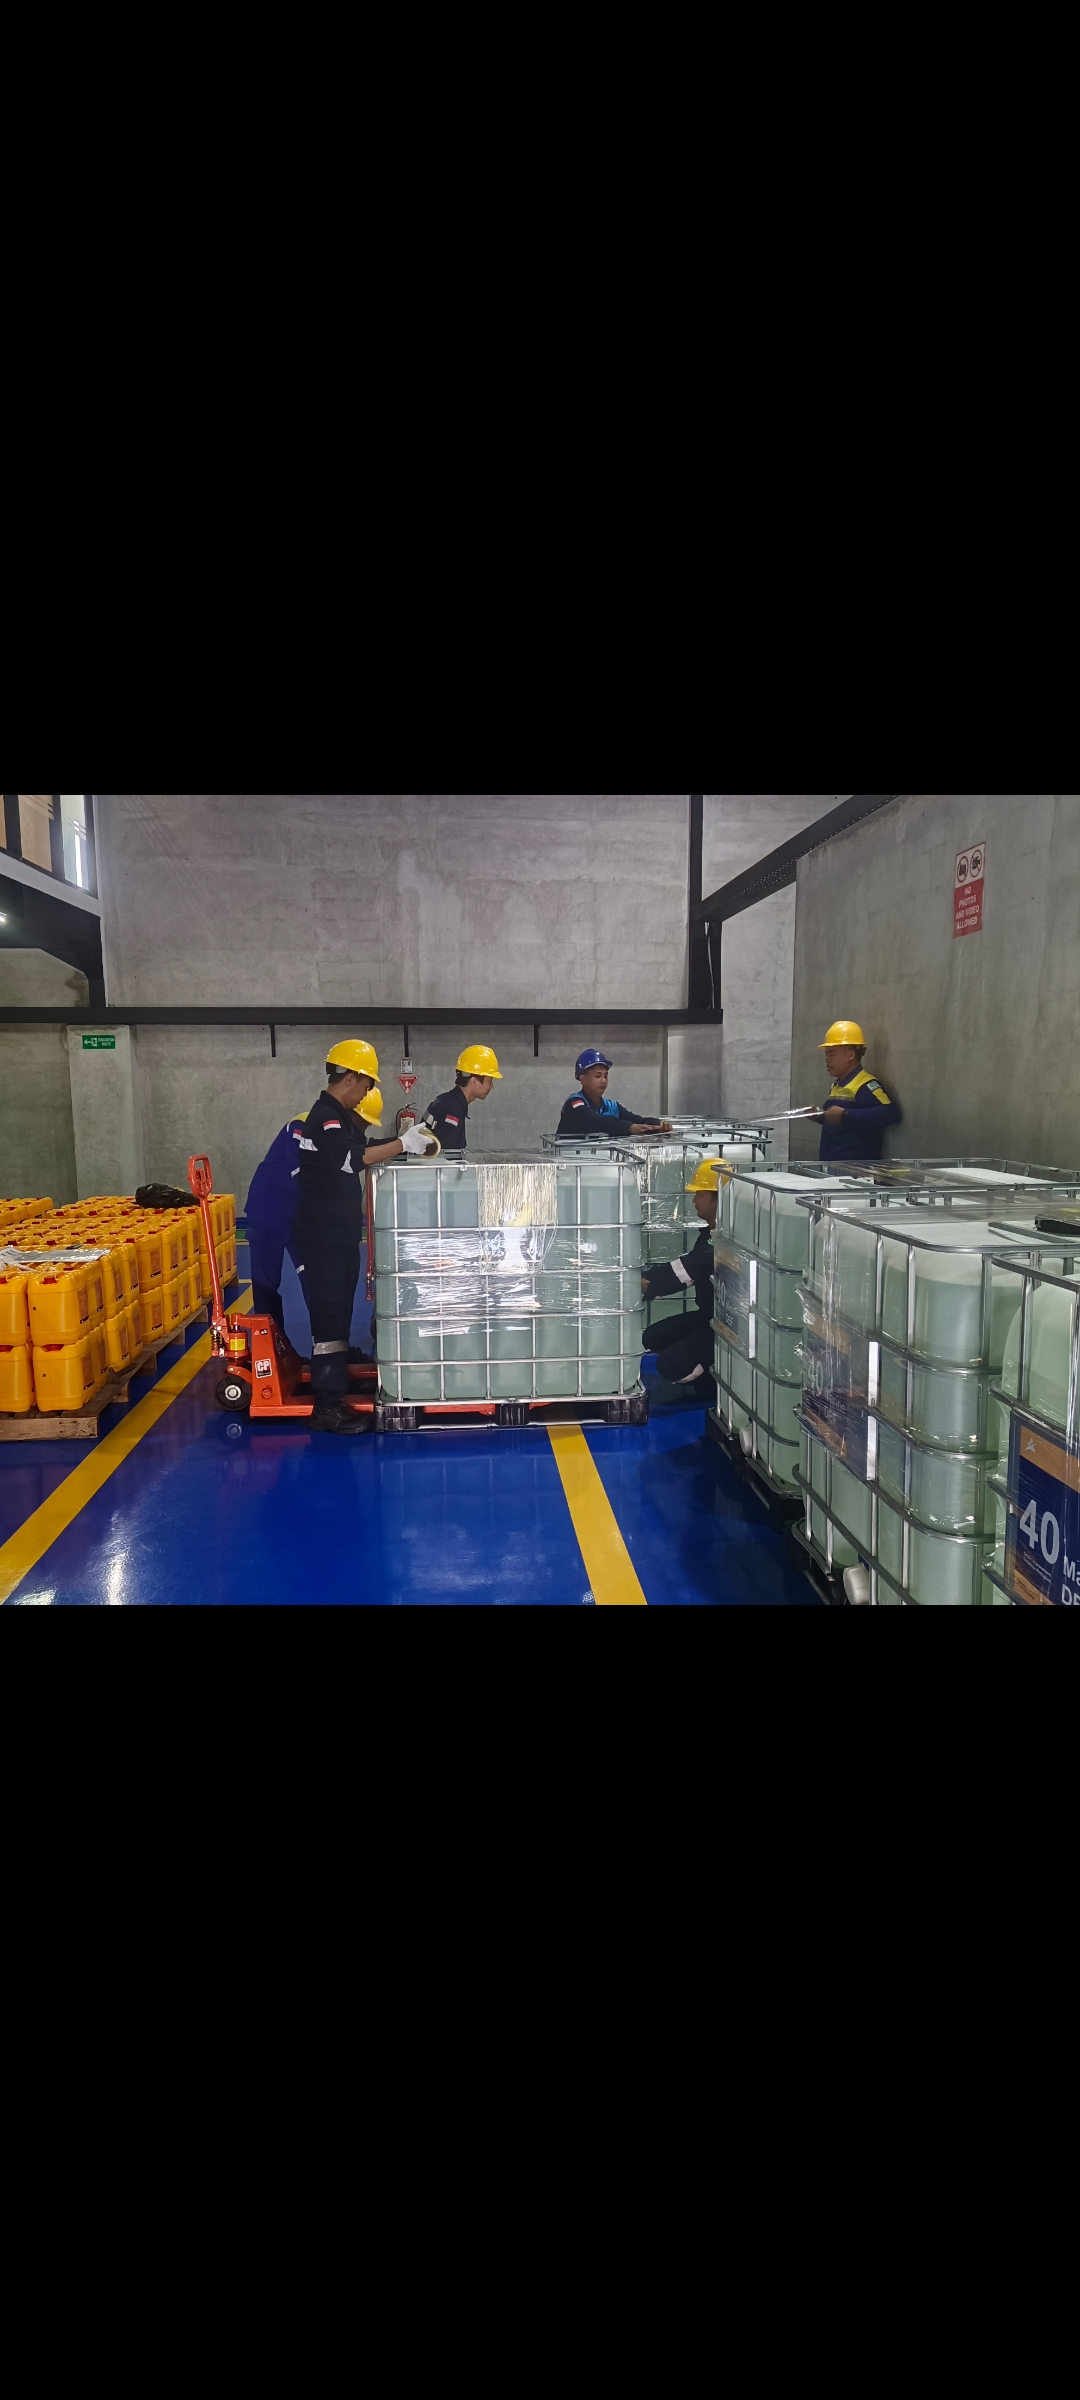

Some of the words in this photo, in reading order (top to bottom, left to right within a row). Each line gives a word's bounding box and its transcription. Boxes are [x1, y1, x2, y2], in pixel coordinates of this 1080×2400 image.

[965, 886, 971, 895] NO
[958, 895, 976, 908] PHOTOS
[956, 910, 964, 919] AND
[965, 905, 979, 916] VIDEO
[957, 916, 977, 930] ALLOWED
[256, 1360, 270, 1372] CP
[1019, 1499, 1060, 1565] 40
